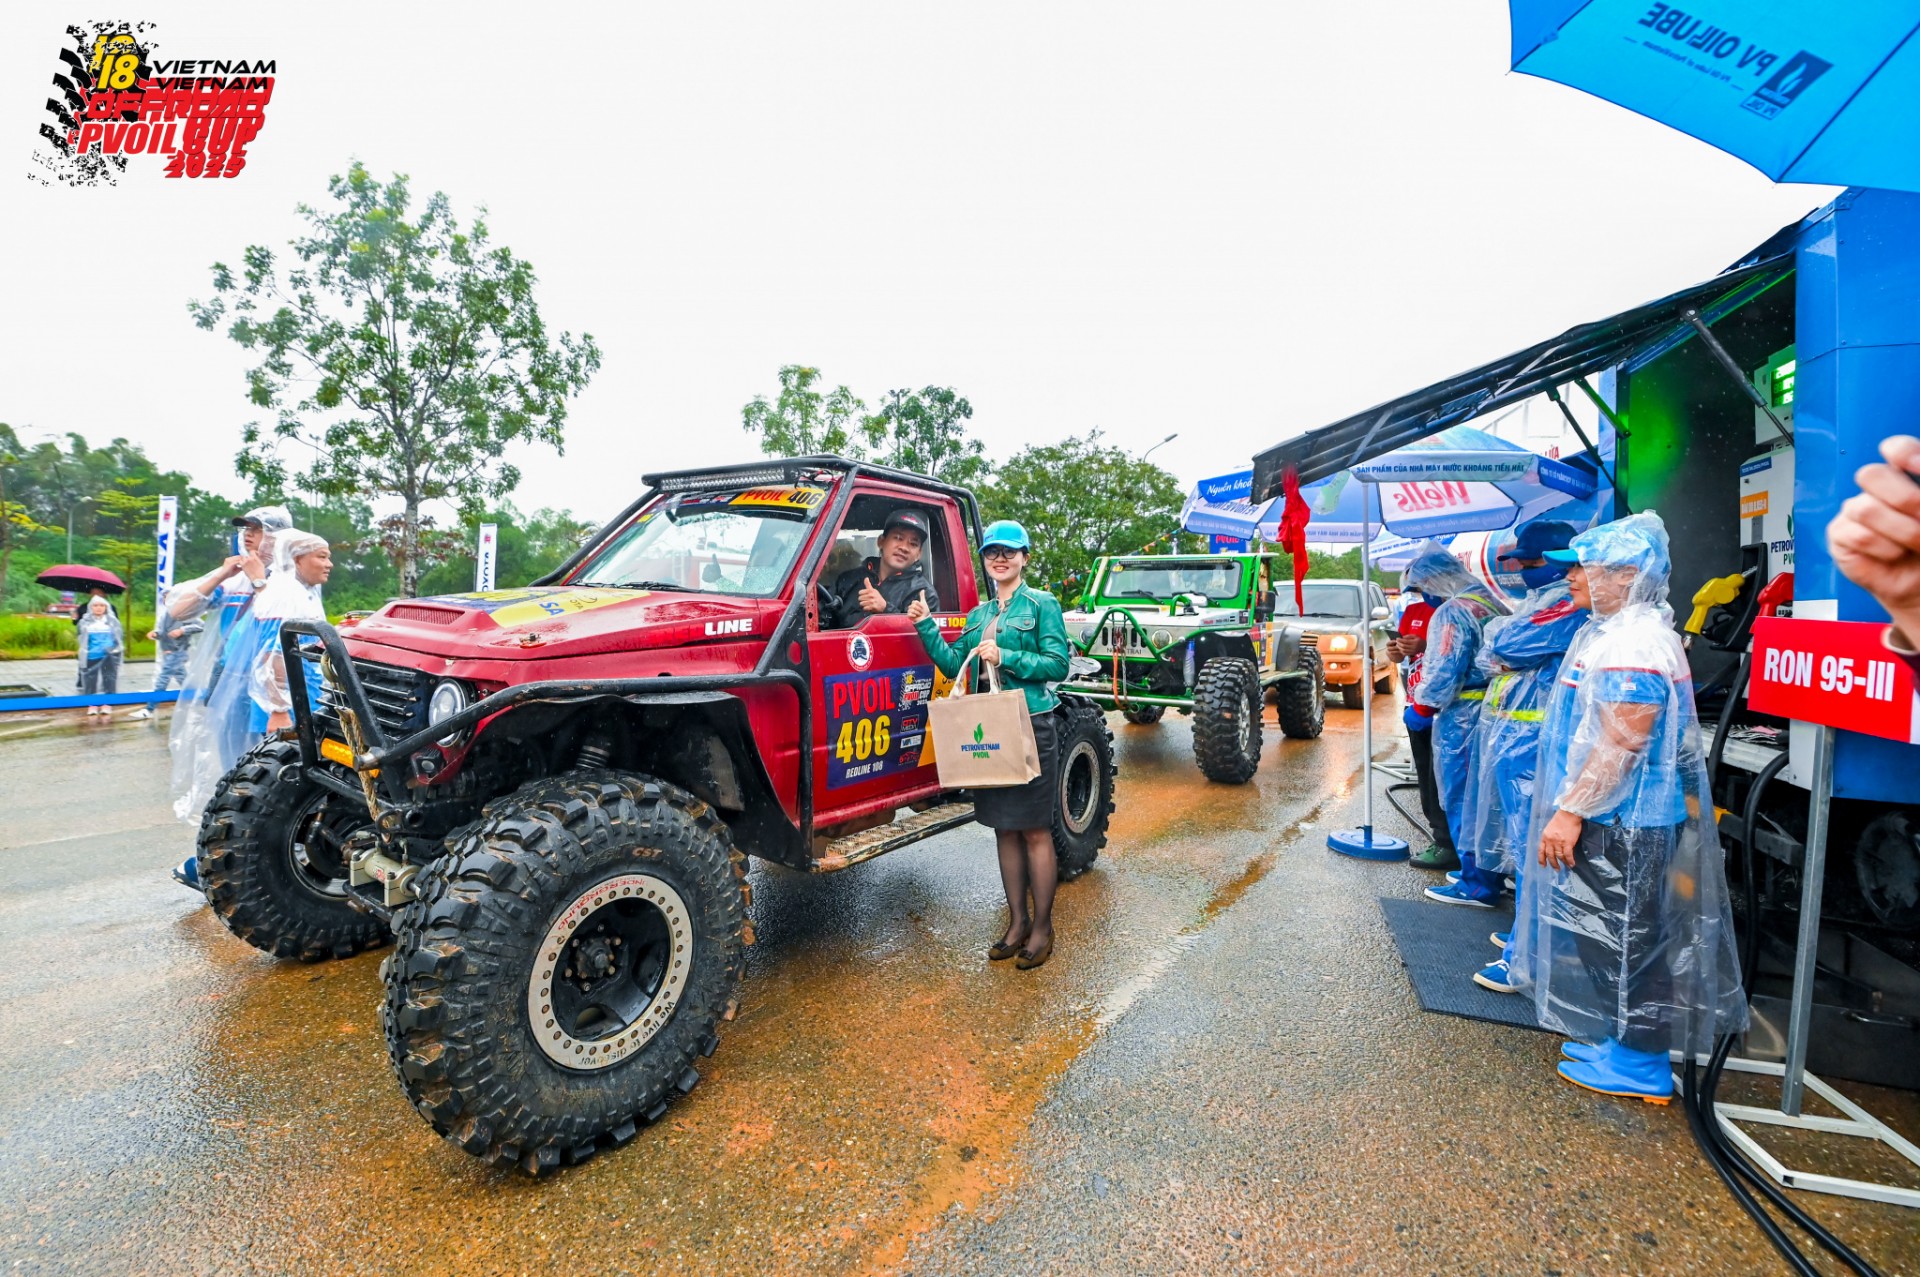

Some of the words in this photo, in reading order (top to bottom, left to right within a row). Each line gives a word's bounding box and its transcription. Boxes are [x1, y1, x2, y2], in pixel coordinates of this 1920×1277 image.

[744, 489, 784, 501] PVOIL
[787, 491, 822, 505] 406
[539, 601, 565, 616] SA
[948, 617, 967, 627] 108
[1763, 647, 1814, 688] RON
[1820, 655, 1896, 702] 95-III
[833, 677, 896, 719] PVOIL
[836, 715, 891, 763] 406
[961, 743, 1000, 752] PETROVIETNAM
[846, 764, 871, 779] REDLINE
[872, 761, 884, 772] 108
[632, 847, 663, 858] CST
[660, 1001, 675, 1019] We
